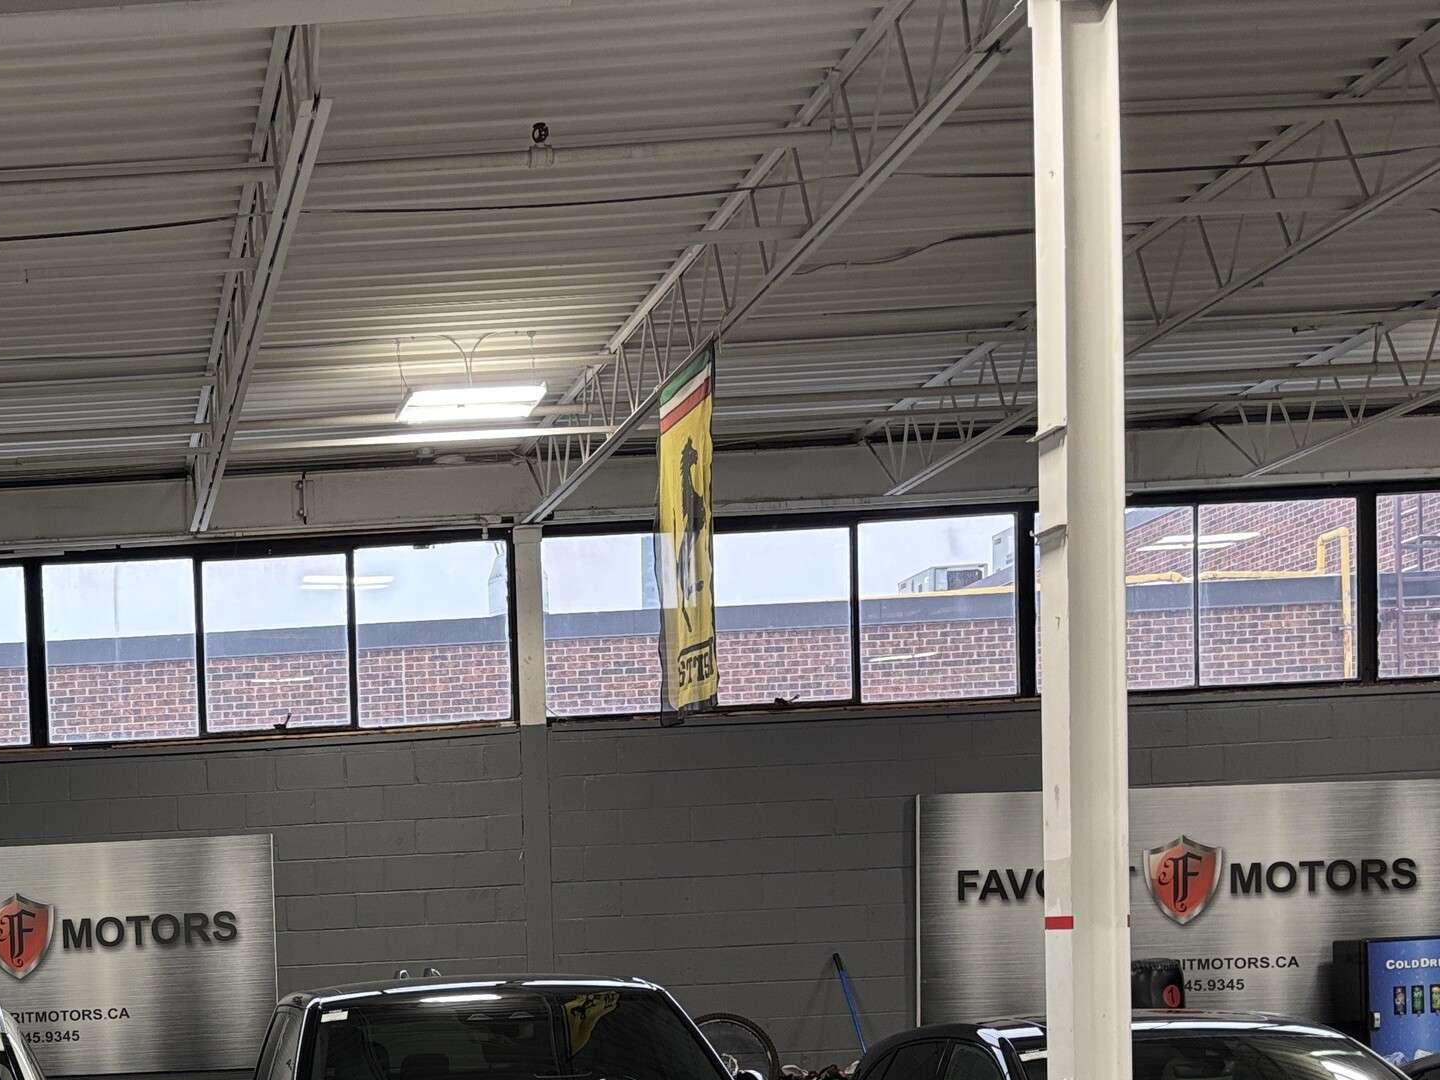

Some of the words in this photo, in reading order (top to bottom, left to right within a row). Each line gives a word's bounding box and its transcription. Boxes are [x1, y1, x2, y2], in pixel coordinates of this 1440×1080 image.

[957, 868, 1045, 902] FAV
[1230, 858, 1418, 895] MOTORS
[63, 910, 239, 950] MOTORS
